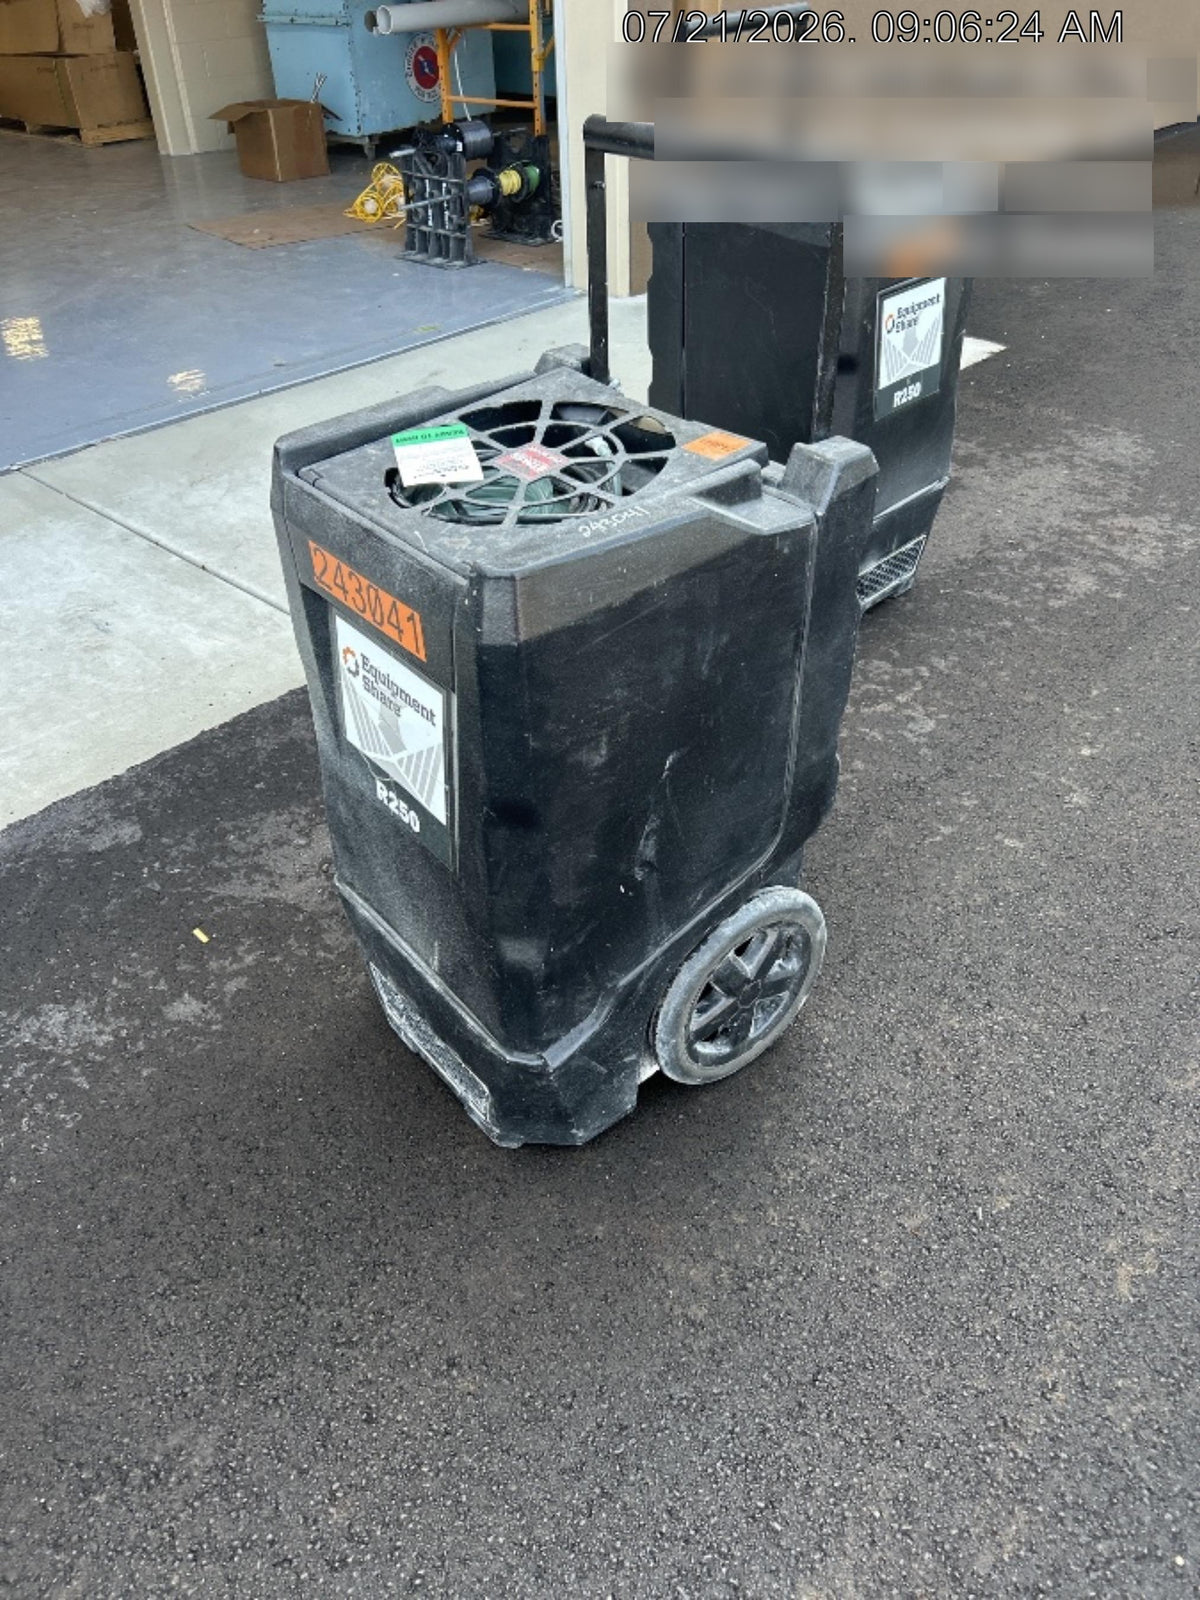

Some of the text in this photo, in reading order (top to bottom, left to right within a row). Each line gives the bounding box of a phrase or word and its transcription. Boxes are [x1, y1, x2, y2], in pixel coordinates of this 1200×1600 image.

[892, 381, 922, 408] R250
[312, 548, 421, 656] 243041
[360, 652, 437, 727] Equipment
[361, 674, 402, 718] Share
[376, 778, 421, 833] R250
